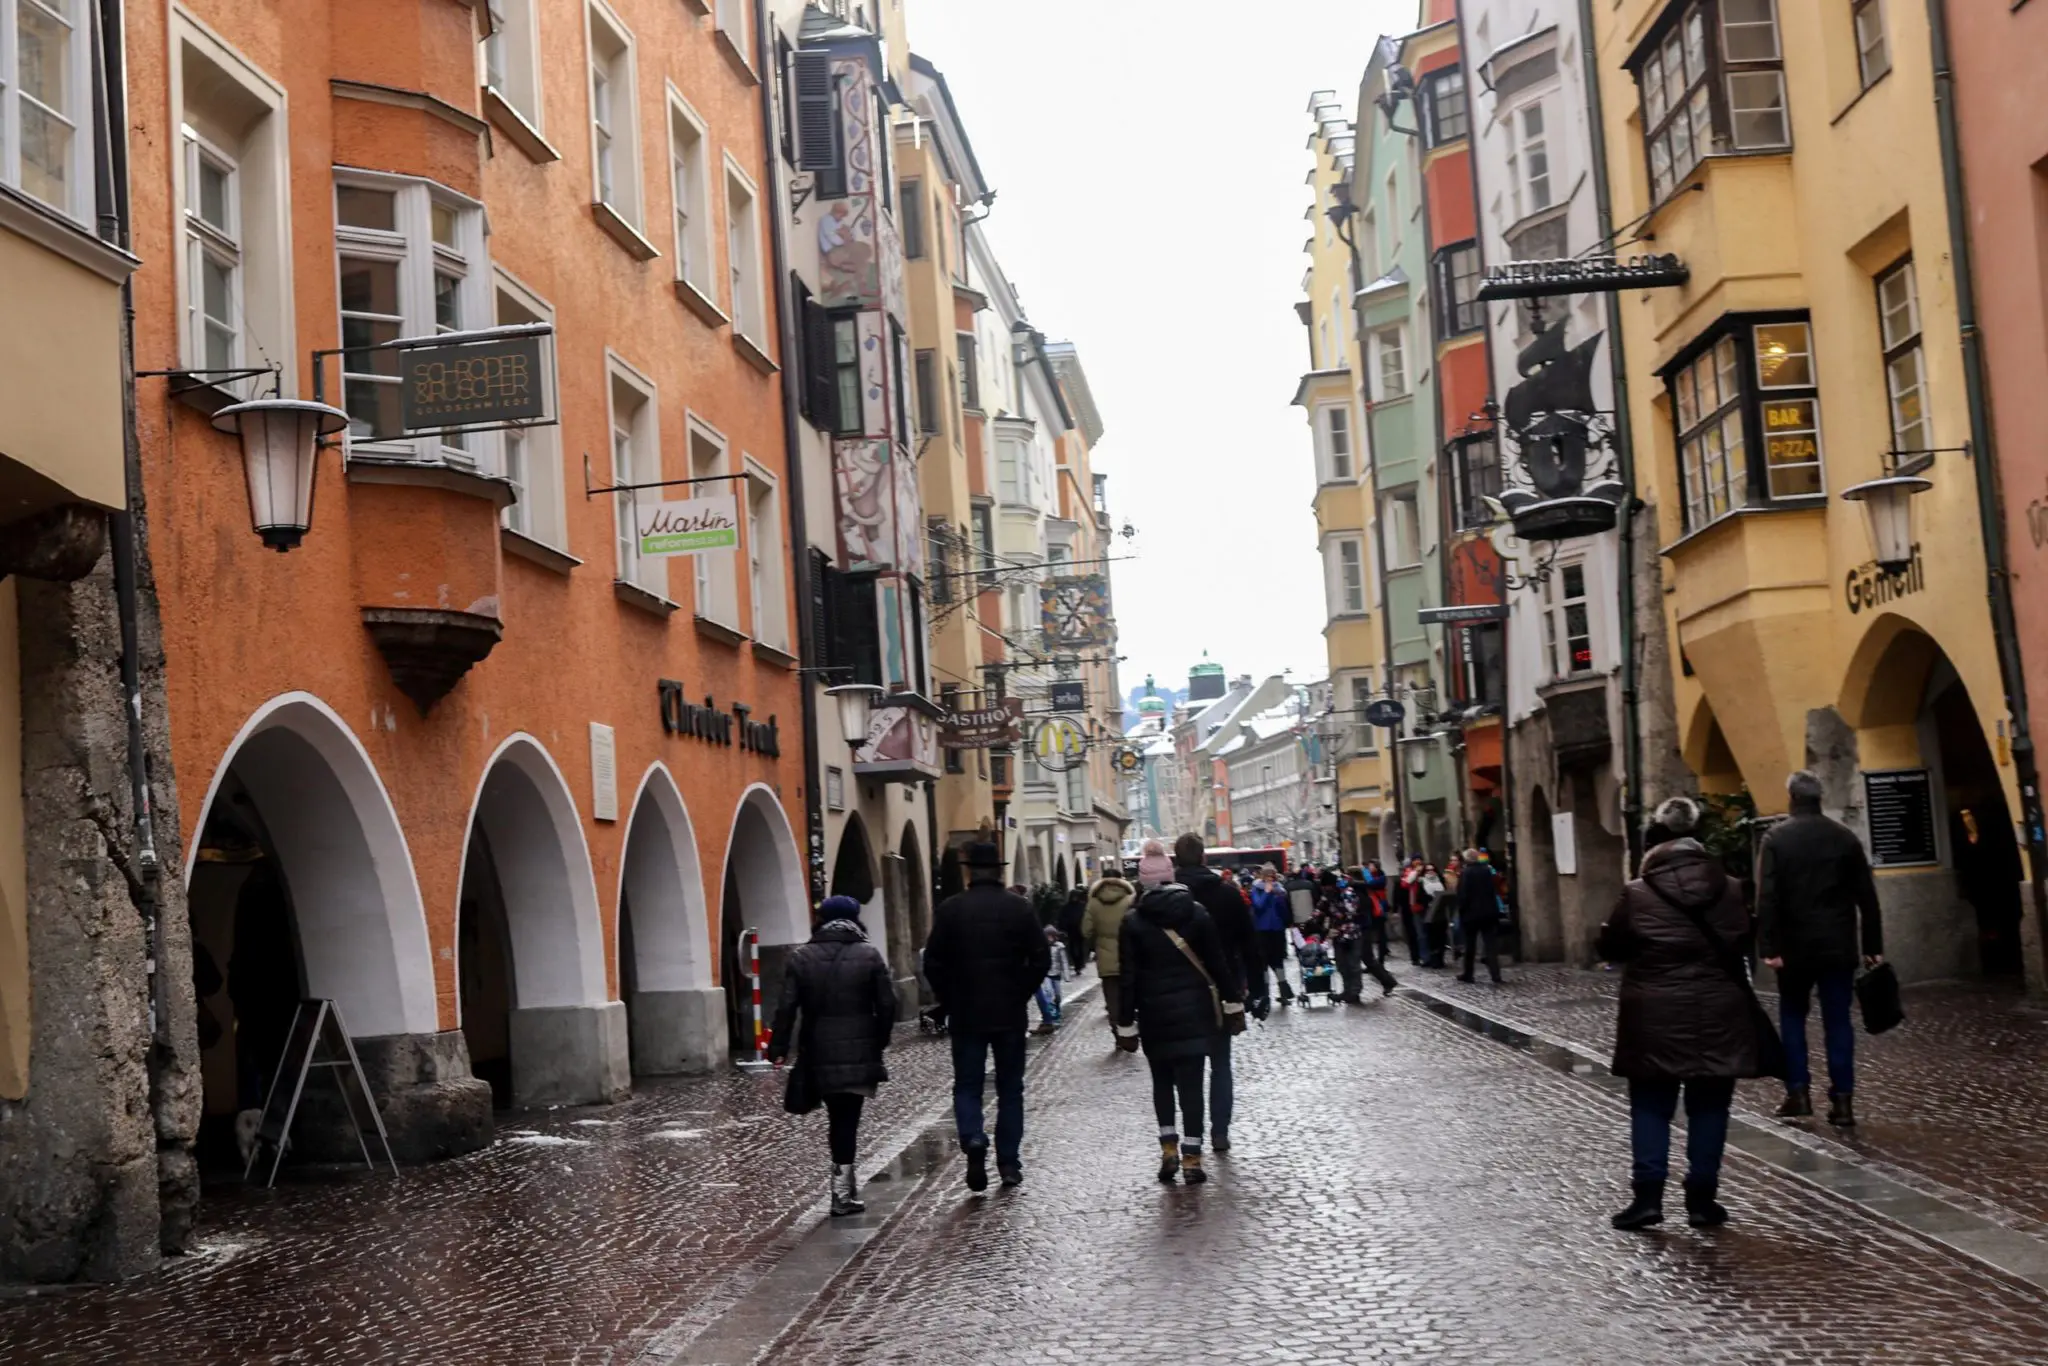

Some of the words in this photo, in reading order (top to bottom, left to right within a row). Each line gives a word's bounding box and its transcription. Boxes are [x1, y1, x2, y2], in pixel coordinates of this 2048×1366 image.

[416, 398, 530, 415] GOLDSCHMIEDE
[1767, 408, 1801, 426] BAR
[1770, 439, 1815, 457] PIZZA
[640, 508, 735, 537] Martin
